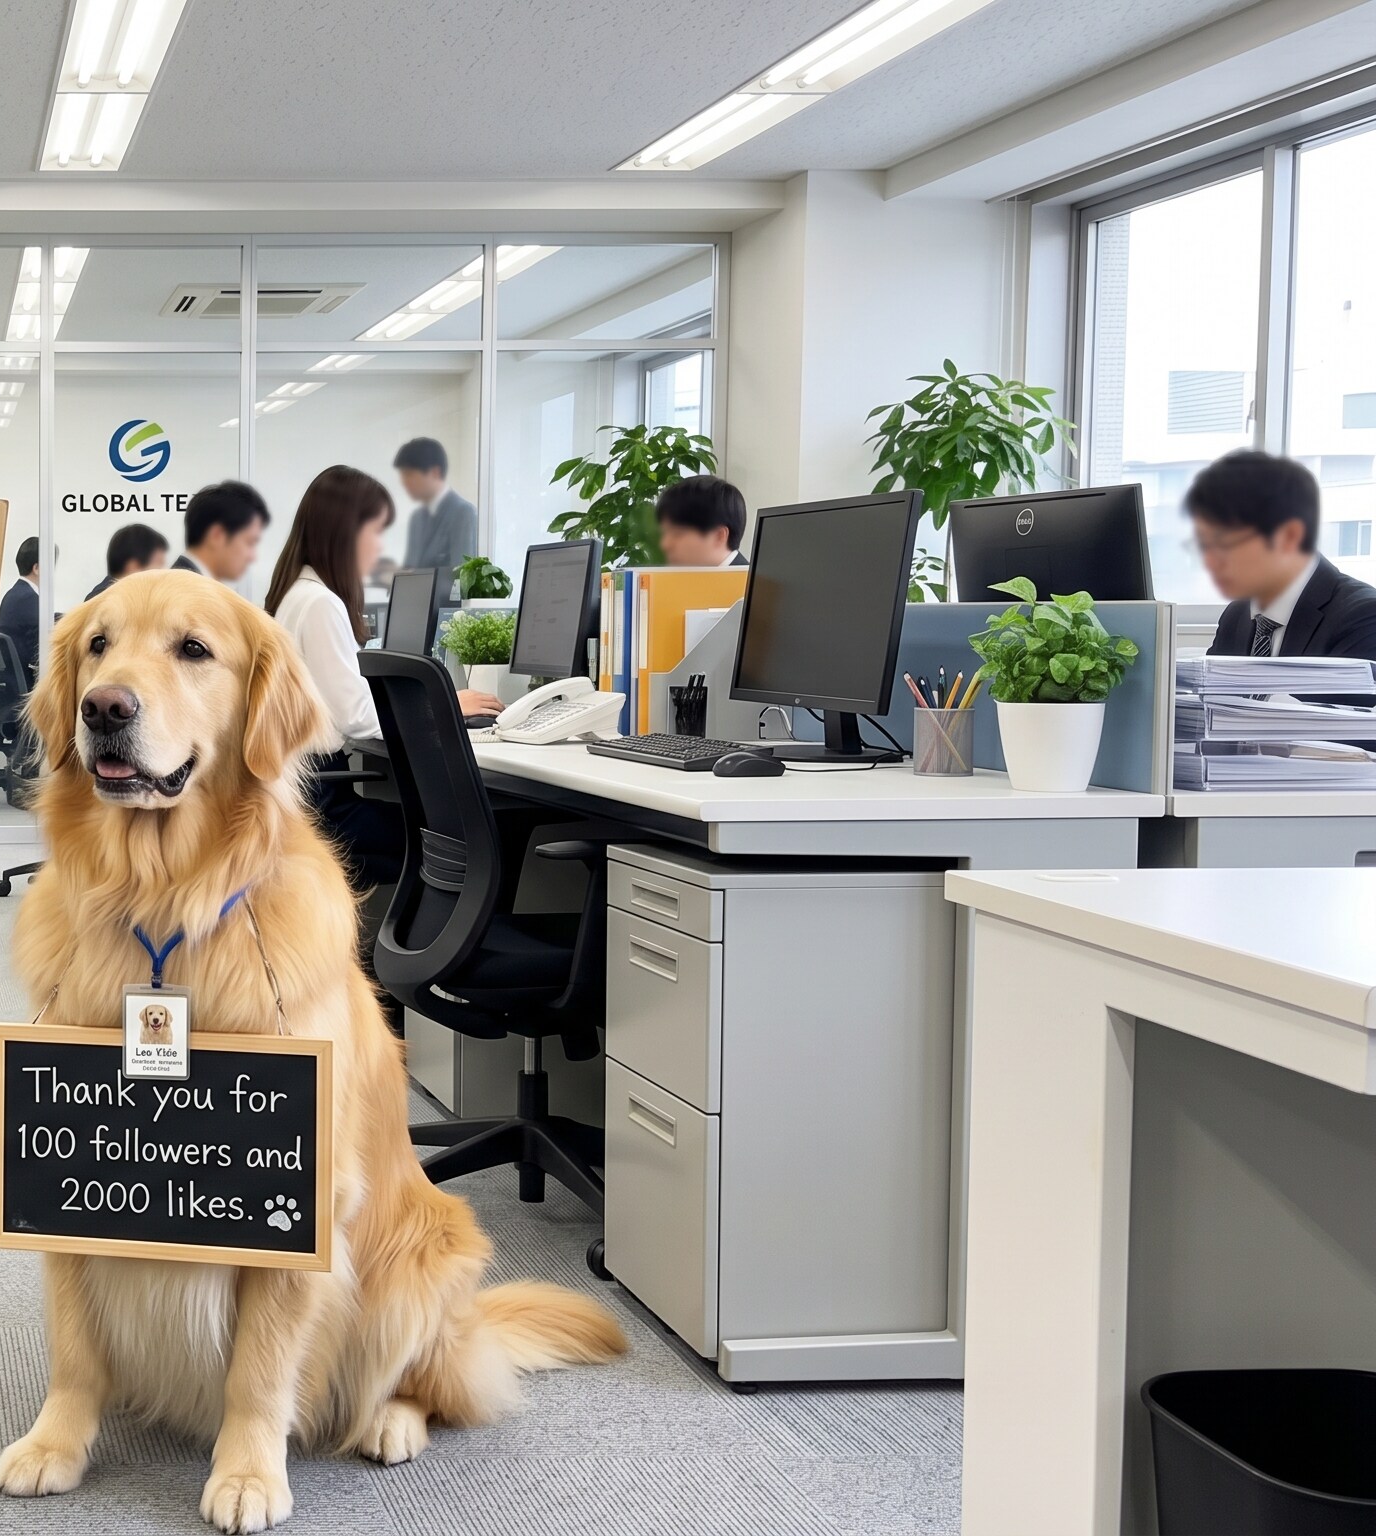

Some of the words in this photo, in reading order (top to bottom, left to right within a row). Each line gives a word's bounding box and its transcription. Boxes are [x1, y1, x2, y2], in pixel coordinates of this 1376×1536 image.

[61, 494, 155, 513] GLOBAL
[161, 494, 194, 513] TE
[22, 1066, 136, 1107] Thank
[152, 1086, 214, 1122] you
[229, 1074, 288, 1113] for
[18, 1123, 76, 1159] 100
[89, 1124, 232, 1167] followers
[246, 1135, 303, 1171] and
[61, 1177, 150, 1214] 2000
[168, 1179, 253, 1221] likes.
